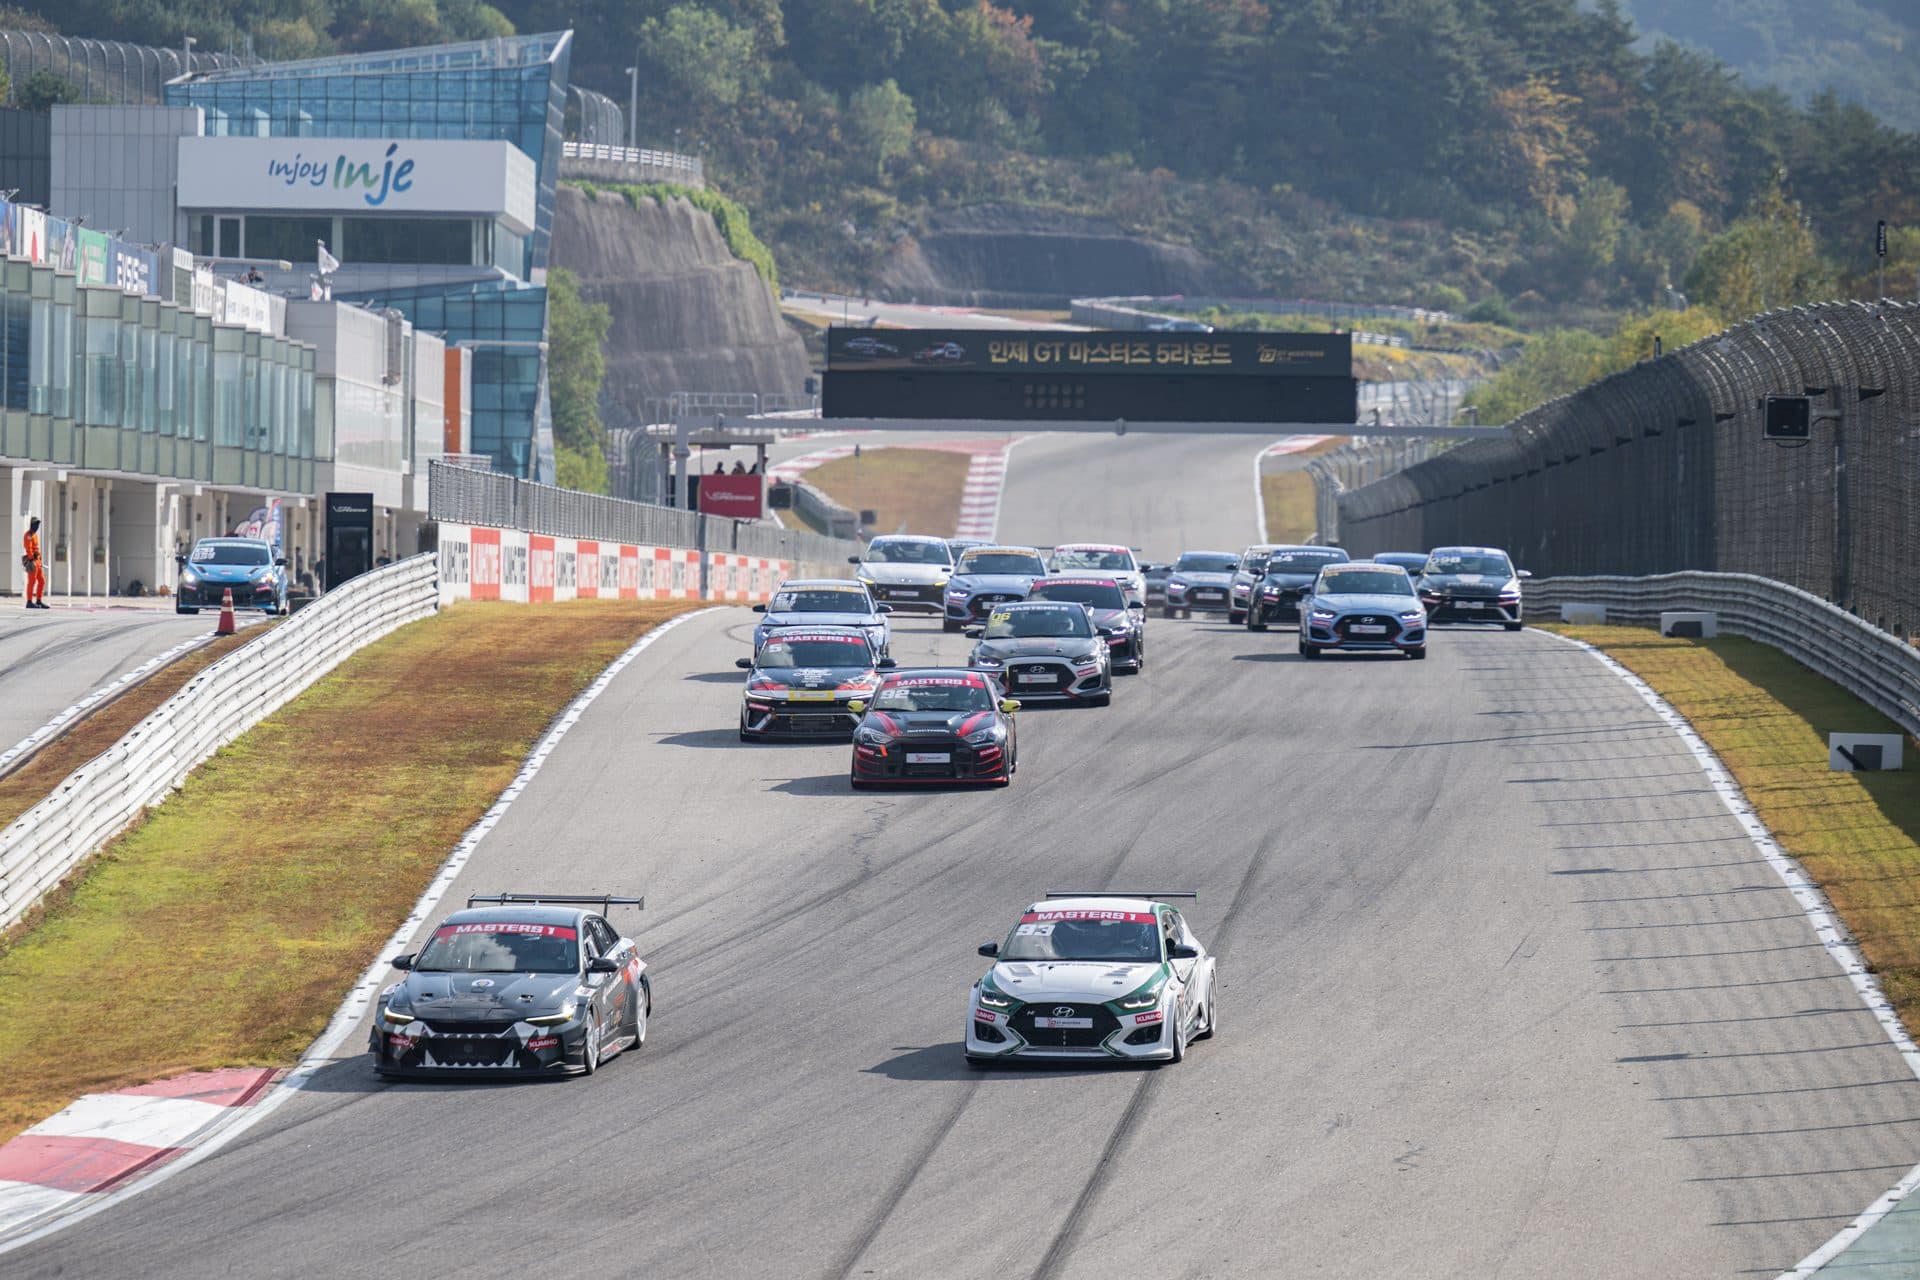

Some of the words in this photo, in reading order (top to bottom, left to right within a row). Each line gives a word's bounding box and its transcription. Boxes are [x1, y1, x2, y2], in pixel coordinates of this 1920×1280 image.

[268, 153, 328, 186] Injoy
[333, 142, 415, 206] Inje
[988, 341, 1028, 363] 인제
[1033, 341, 1064, 363] GT
[1069, 341, 1152, 364] 마스터즈
[1157, 341, 1233, 364] 5라운드
[1037, 911, 1126, 921] MASTERS
[455, 923, 544, 934] MASTERS
[546, 926, 555, 935] 1
